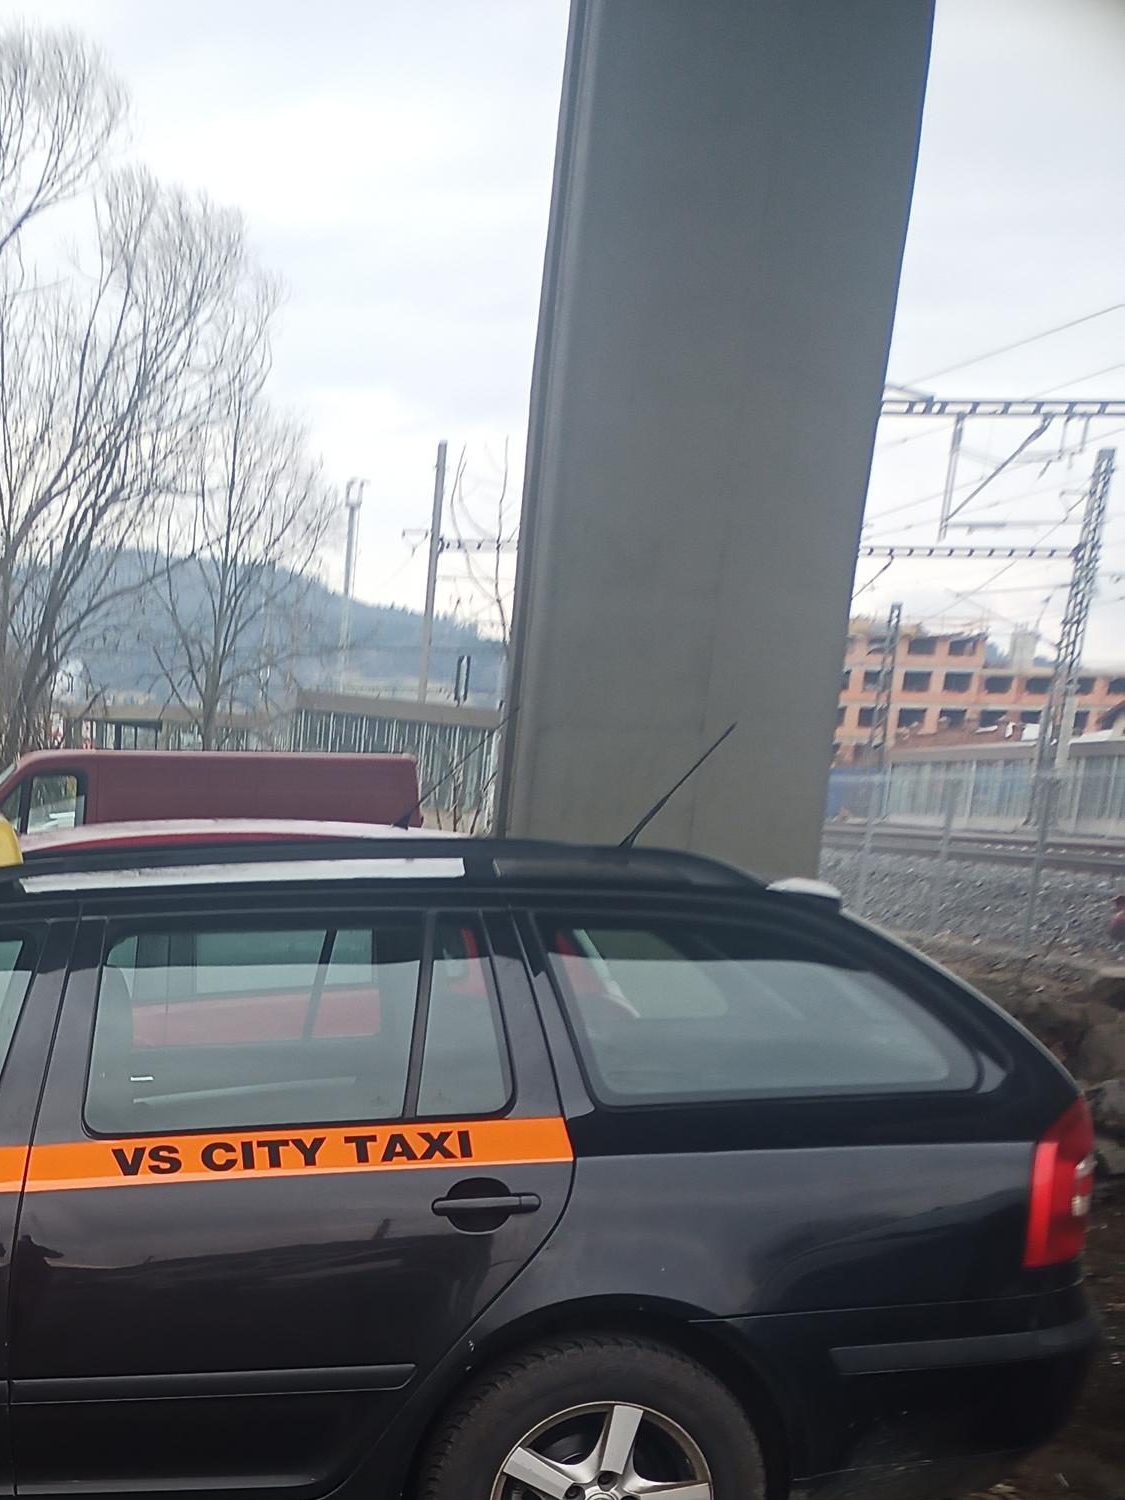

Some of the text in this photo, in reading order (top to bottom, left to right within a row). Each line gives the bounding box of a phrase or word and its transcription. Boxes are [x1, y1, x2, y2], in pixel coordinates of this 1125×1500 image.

[112, 1130, 473, 1176] VS CITY TAXI
